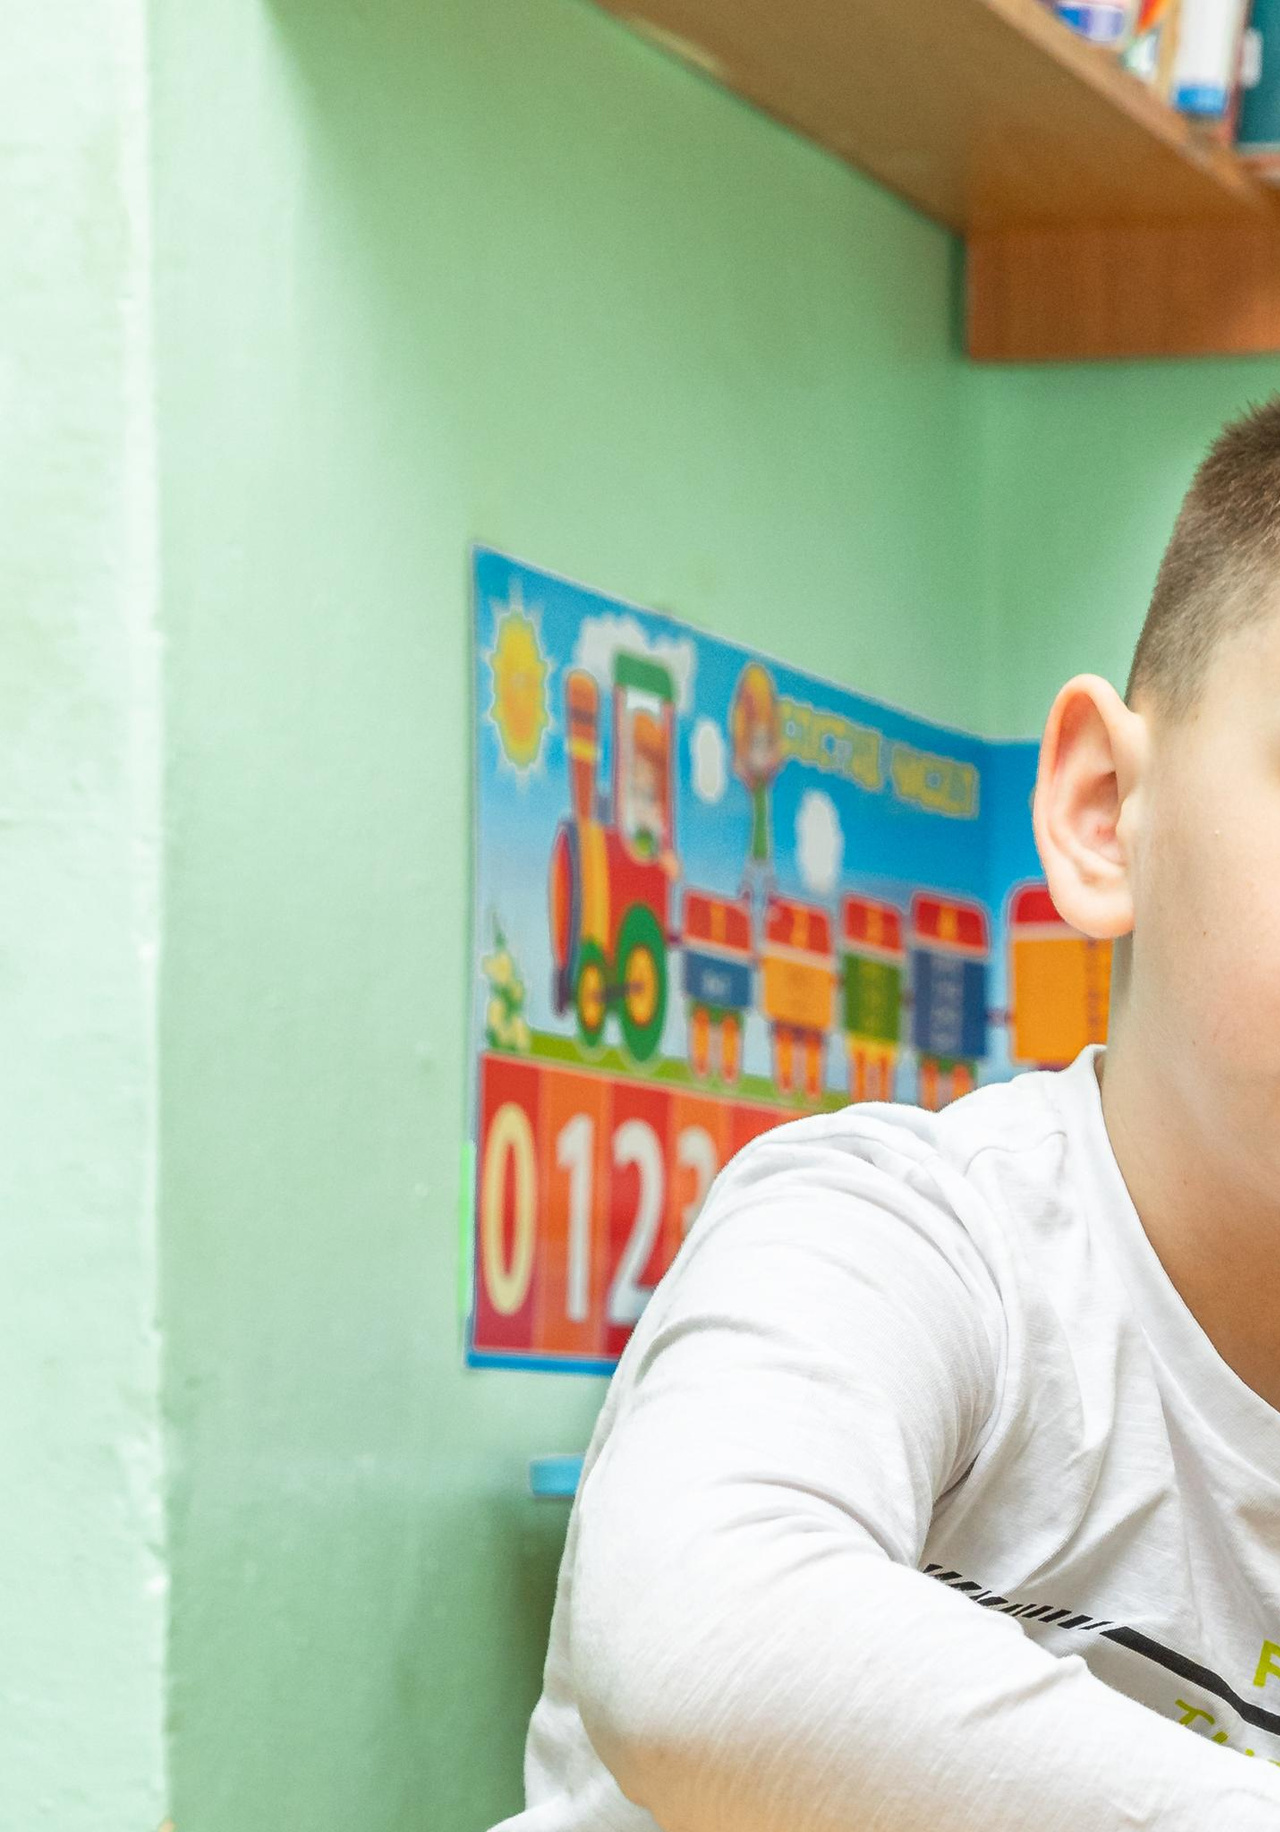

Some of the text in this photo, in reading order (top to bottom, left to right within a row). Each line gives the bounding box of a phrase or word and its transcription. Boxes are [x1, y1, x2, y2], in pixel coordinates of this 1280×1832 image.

[480, 1101, 537, 1316] 0
[556, 1112, 594, 1322] 1
[607, 1117, 666, 1325] 2
